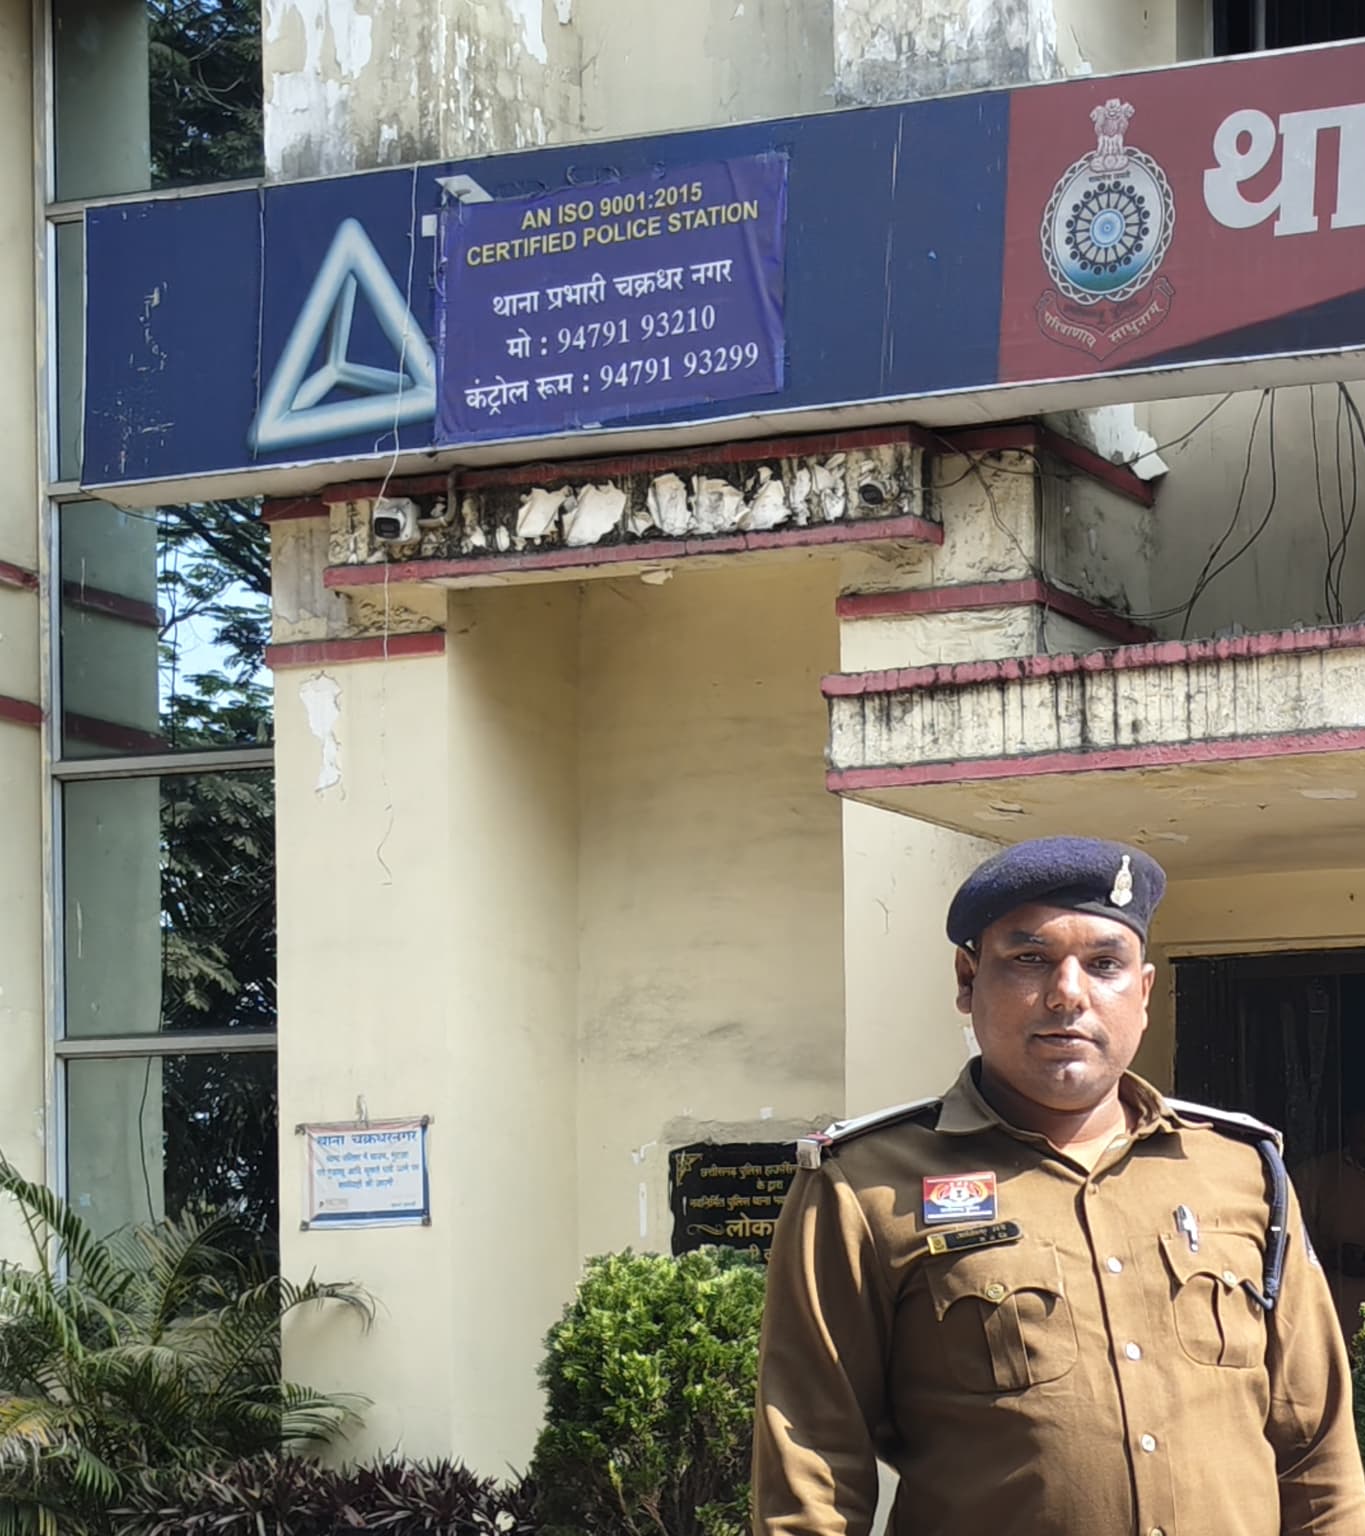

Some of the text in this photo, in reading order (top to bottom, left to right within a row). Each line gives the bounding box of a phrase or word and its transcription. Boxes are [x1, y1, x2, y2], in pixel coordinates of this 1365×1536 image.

[465, 199, 760, 267] CERTIFIED POLICE STATION
[520, 181, 703, 231] AN ISO 9001:2015
[492, 259, 733, 318] थाना प्रभारी चक्रधर नगर
[506, 327, 532, 359] मो
[557, 319, 631, 355] 94791
[640, 303, 717, 342] 93210
[464, 375, 529, 416] कंट्रोल
[535, 372, 574, 400] रूम
[599, 356, 673, 391] 94791
[682, 341, 760, 378] 93299
